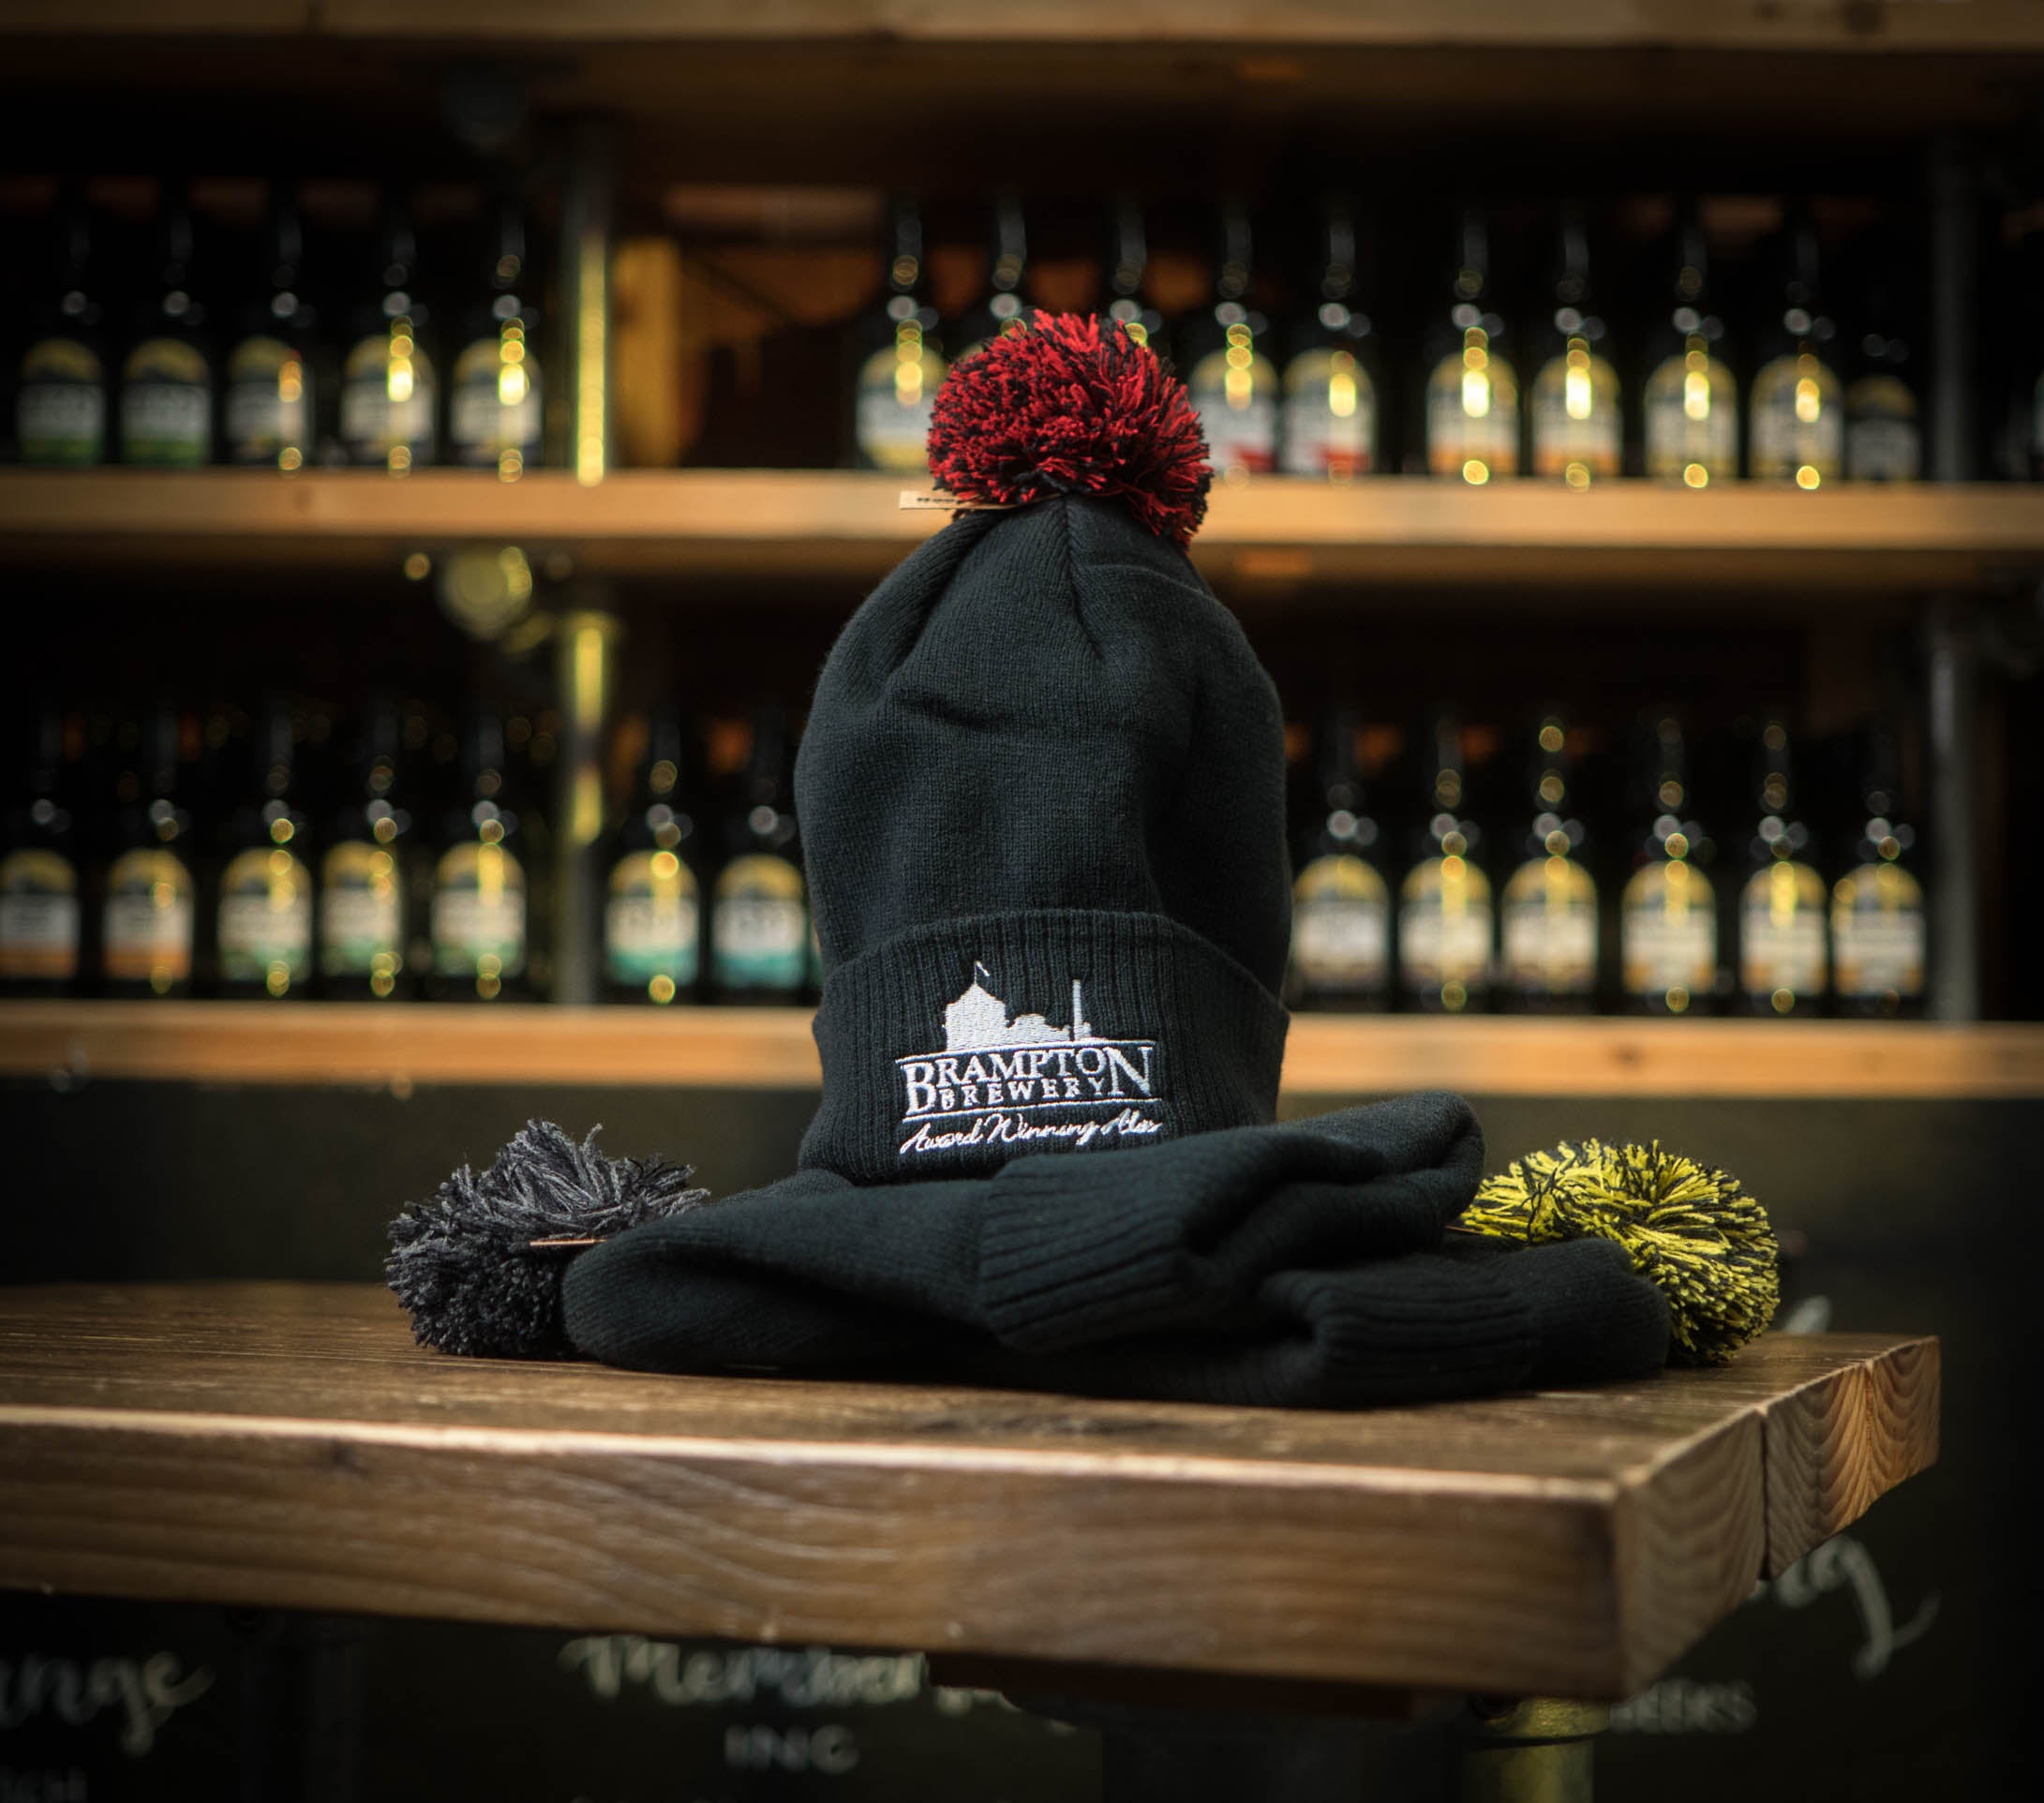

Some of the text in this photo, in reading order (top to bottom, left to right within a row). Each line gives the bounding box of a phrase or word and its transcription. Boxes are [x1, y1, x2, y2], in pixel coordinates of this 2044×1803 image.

[901, 1047, 1154, 1116] BRAMPTON
[939, 1077, 1105, 1110] BREWERY
[899, 1118, 984, 1154] Award
[984, 1112, 1099, 1146] Winning
